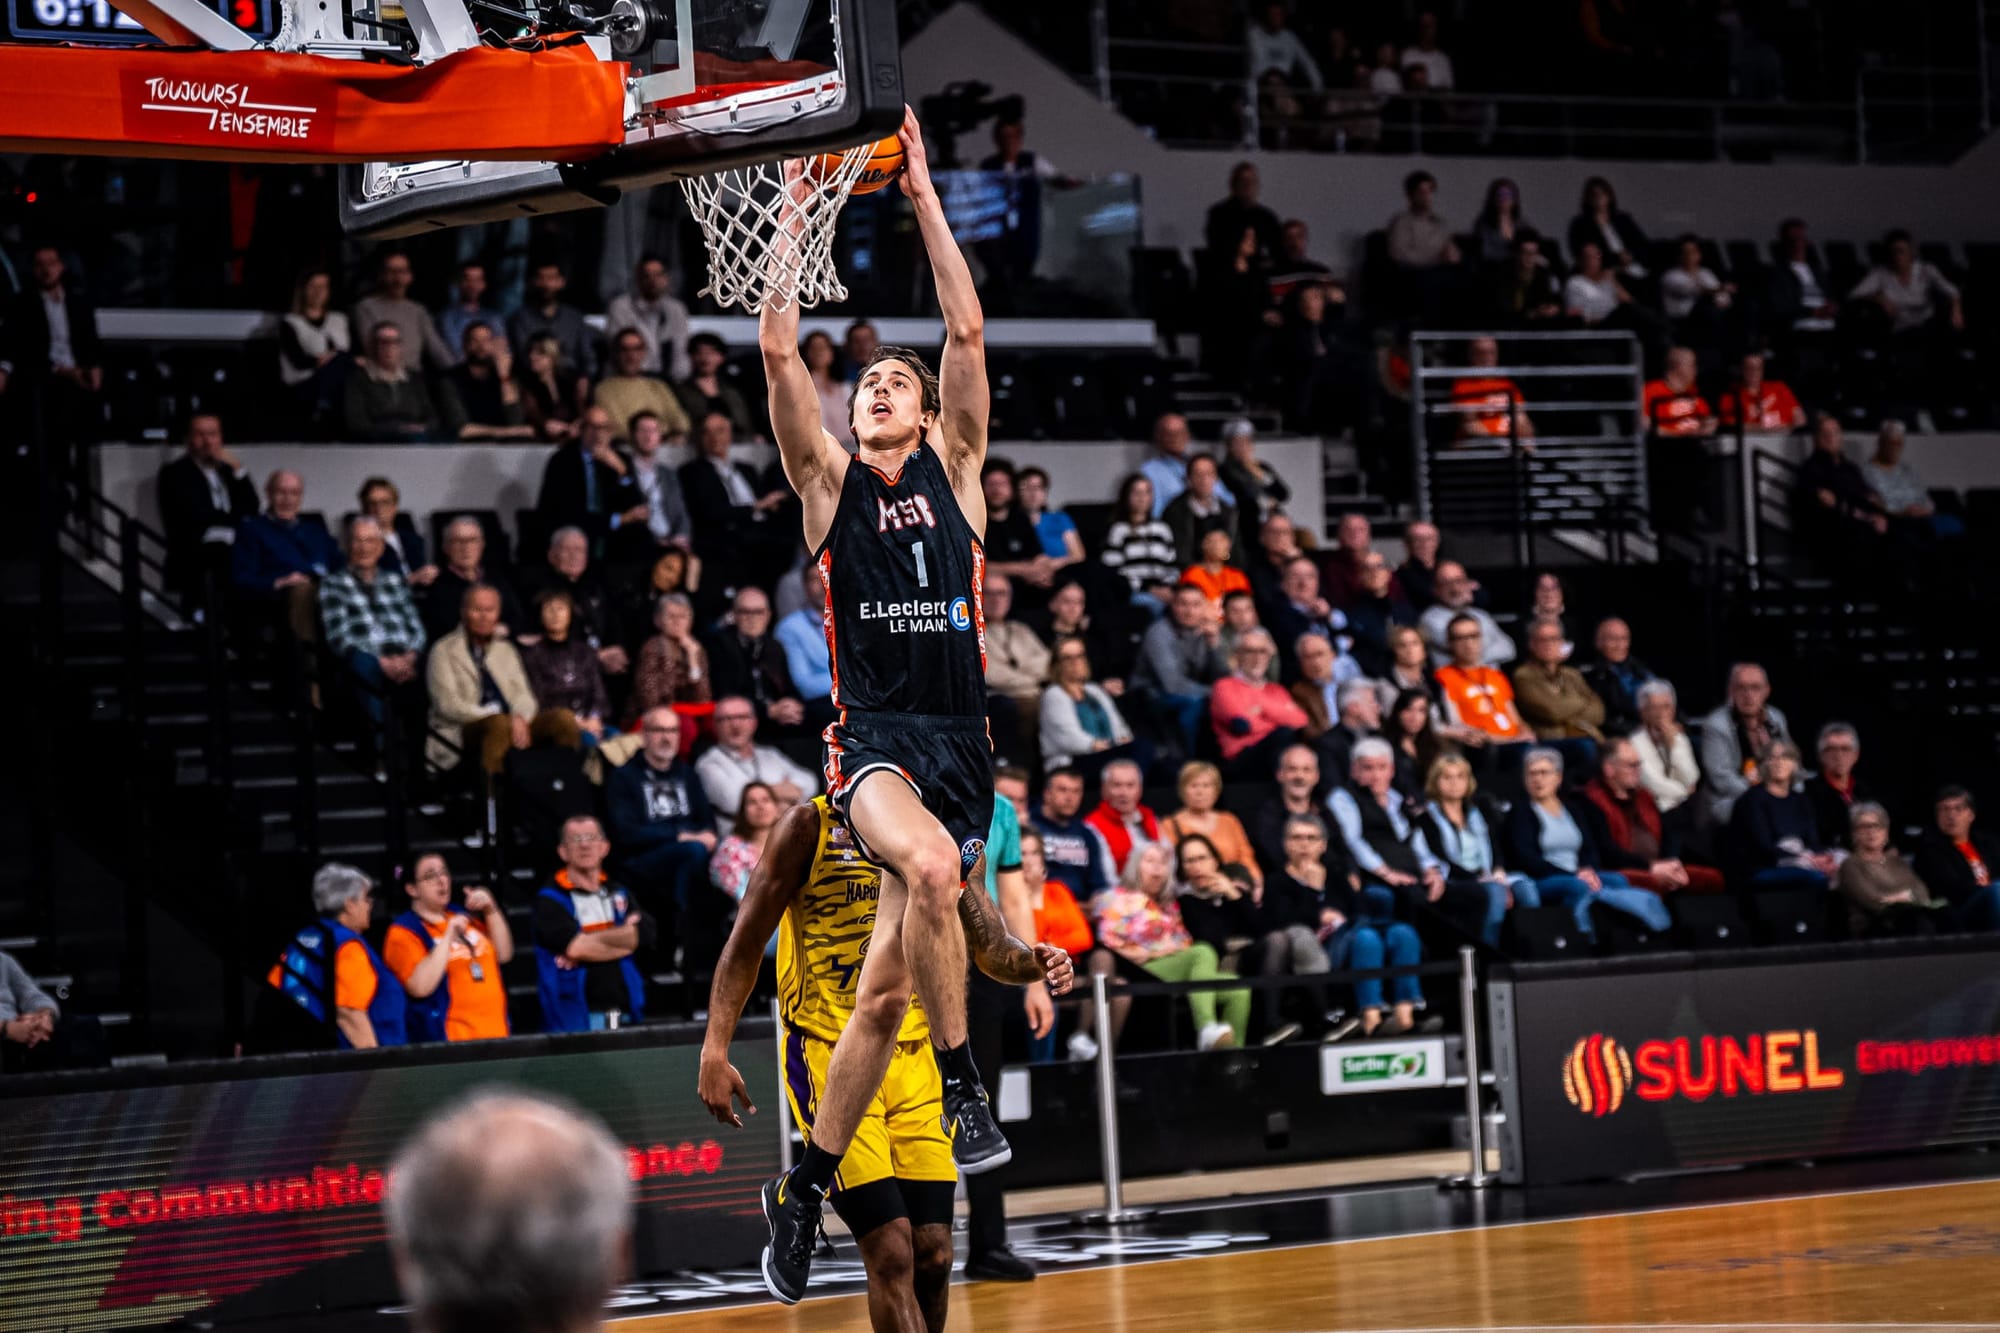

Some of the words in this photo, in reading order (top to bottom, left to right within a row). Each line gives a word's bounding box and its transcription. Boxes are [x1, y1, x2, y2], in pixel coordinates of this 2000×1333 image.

[145, 77, 239, 109] TOUJOURS
[220, 111, 312, 138] ENSEMBLE
[911, 541, 929, 587] 1
[890, 620, 906, 633] LE
[1635, 1029, 1844, 1102] SUNEL
[1857, 1035, 2000, 1076] Empowe
[94, 1162, 387, 1228] Communitie
